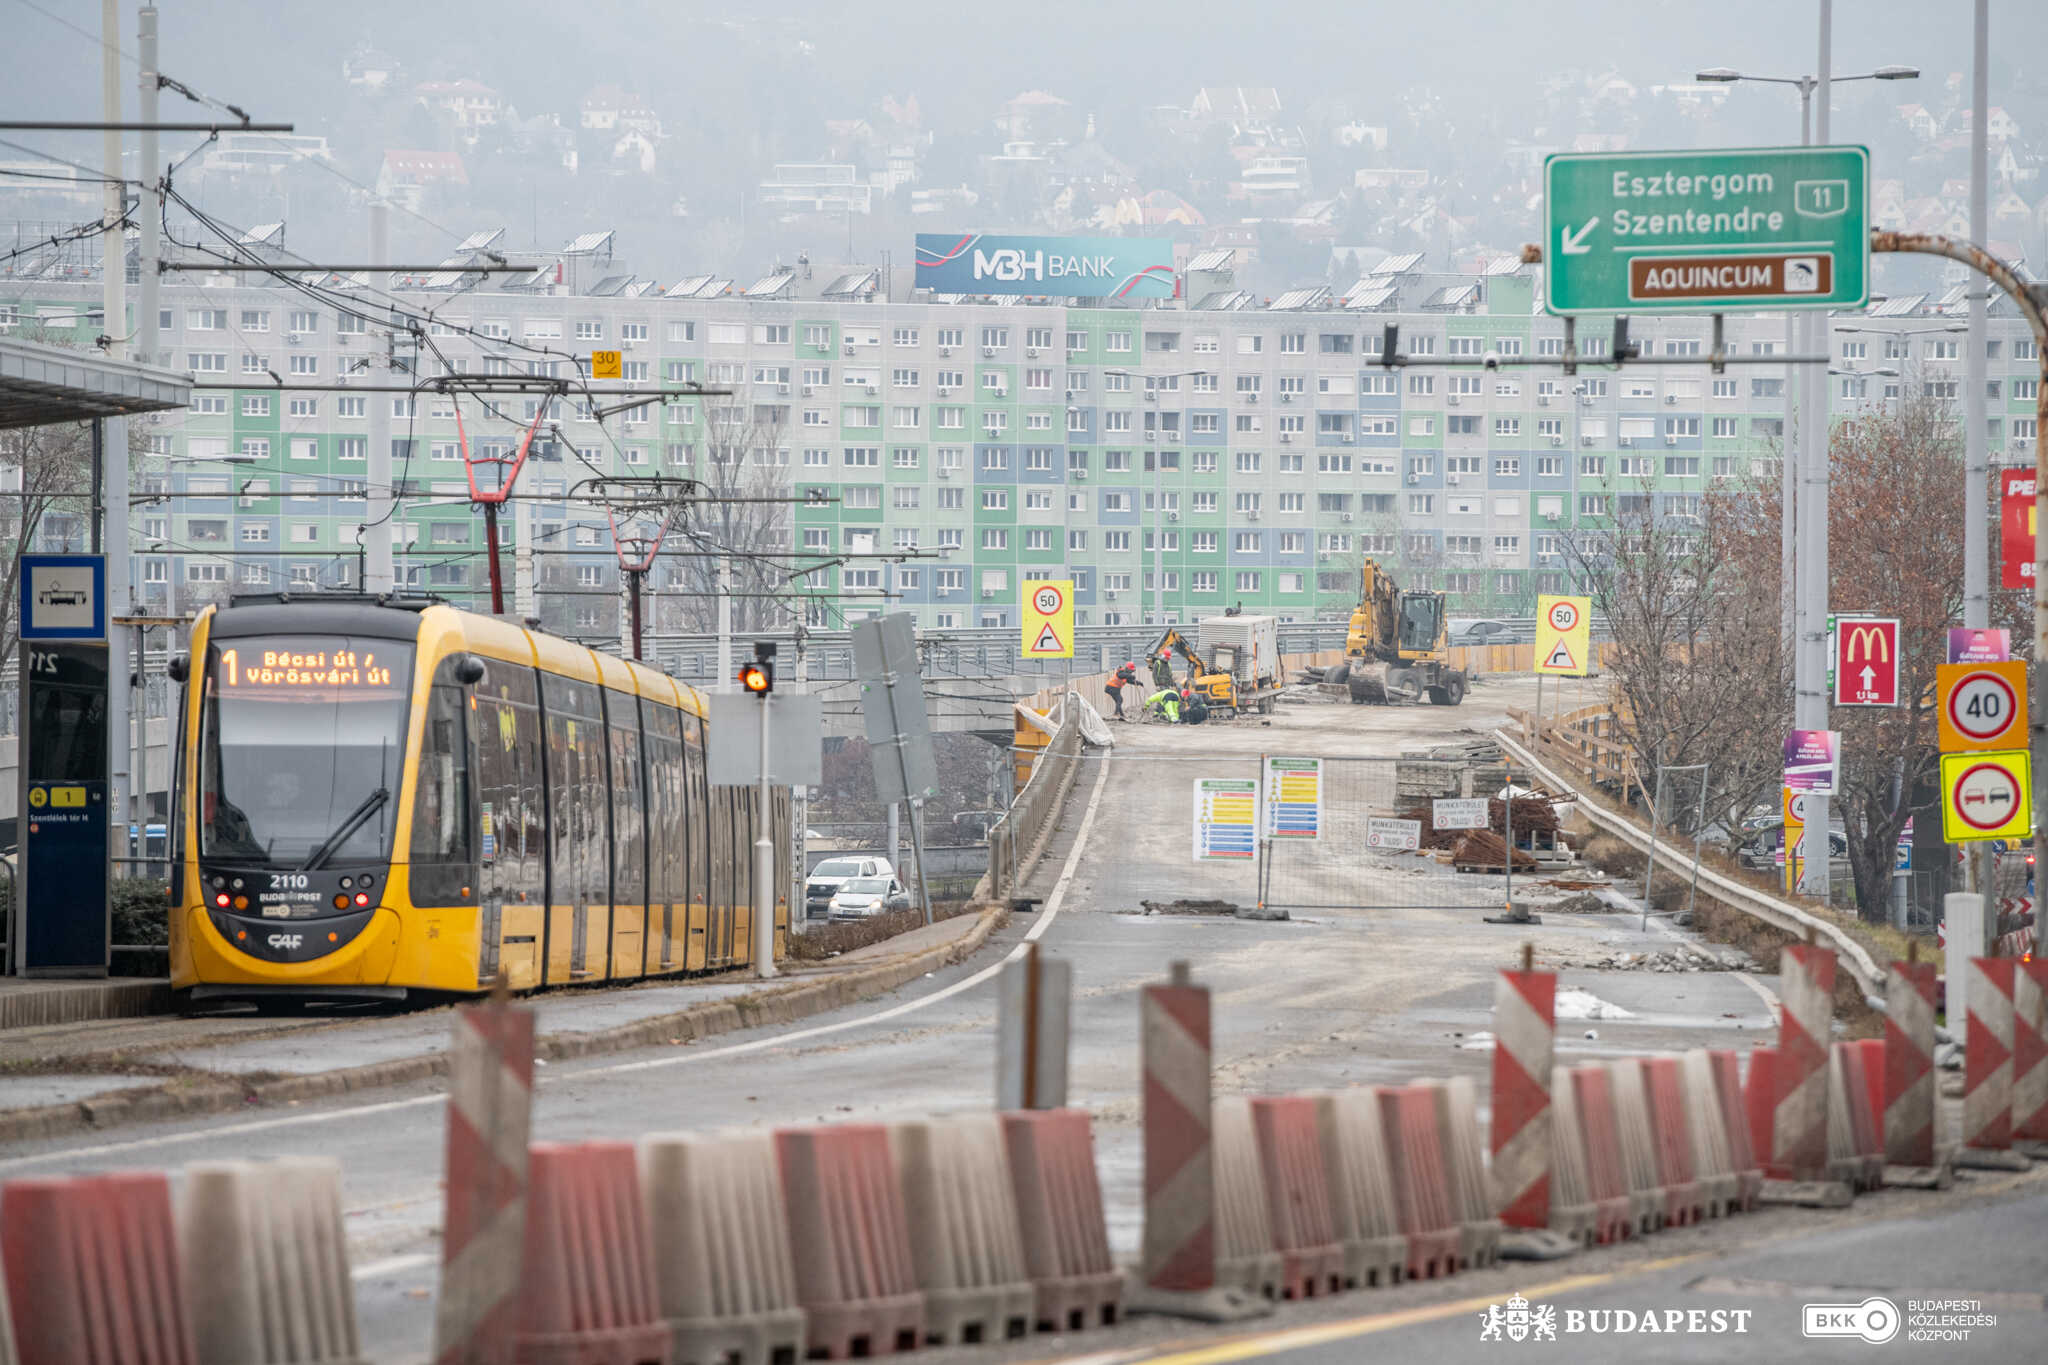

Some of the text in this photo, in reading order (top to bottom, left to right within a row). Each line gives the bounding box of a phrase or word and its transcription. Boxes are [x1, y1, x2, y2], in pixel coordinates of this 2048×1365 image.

[1612, 170, 1774, 200] Esztergom
[1812, 187, 1832, 208] 11
[1612, 205, 1784, 235] Szentendre
[973, 249, 1116, 281] MBH BANK
[1644, 265, 1772, 290] AQUINCUM
[596, 350, 615, 364] 30
[2008, 480, 2037, 496] PE
[1040, 595, 1055, 607] 50
[1556, 610, 1571, 623] 50
[222, 649, 238, 686] 1
[264, 650, 326, 668] Bécsi
[333, 650, 357, 668] út
[246, 667, 391, 685] Vörösvári út
[1965, 692, 2000, 718] 40
[65, 791, 71, 802] 1
[1796, 801, 1804, 811] 4
[270, 875, 309, 889] 2110
[267, 934, 303, 949] CAF
